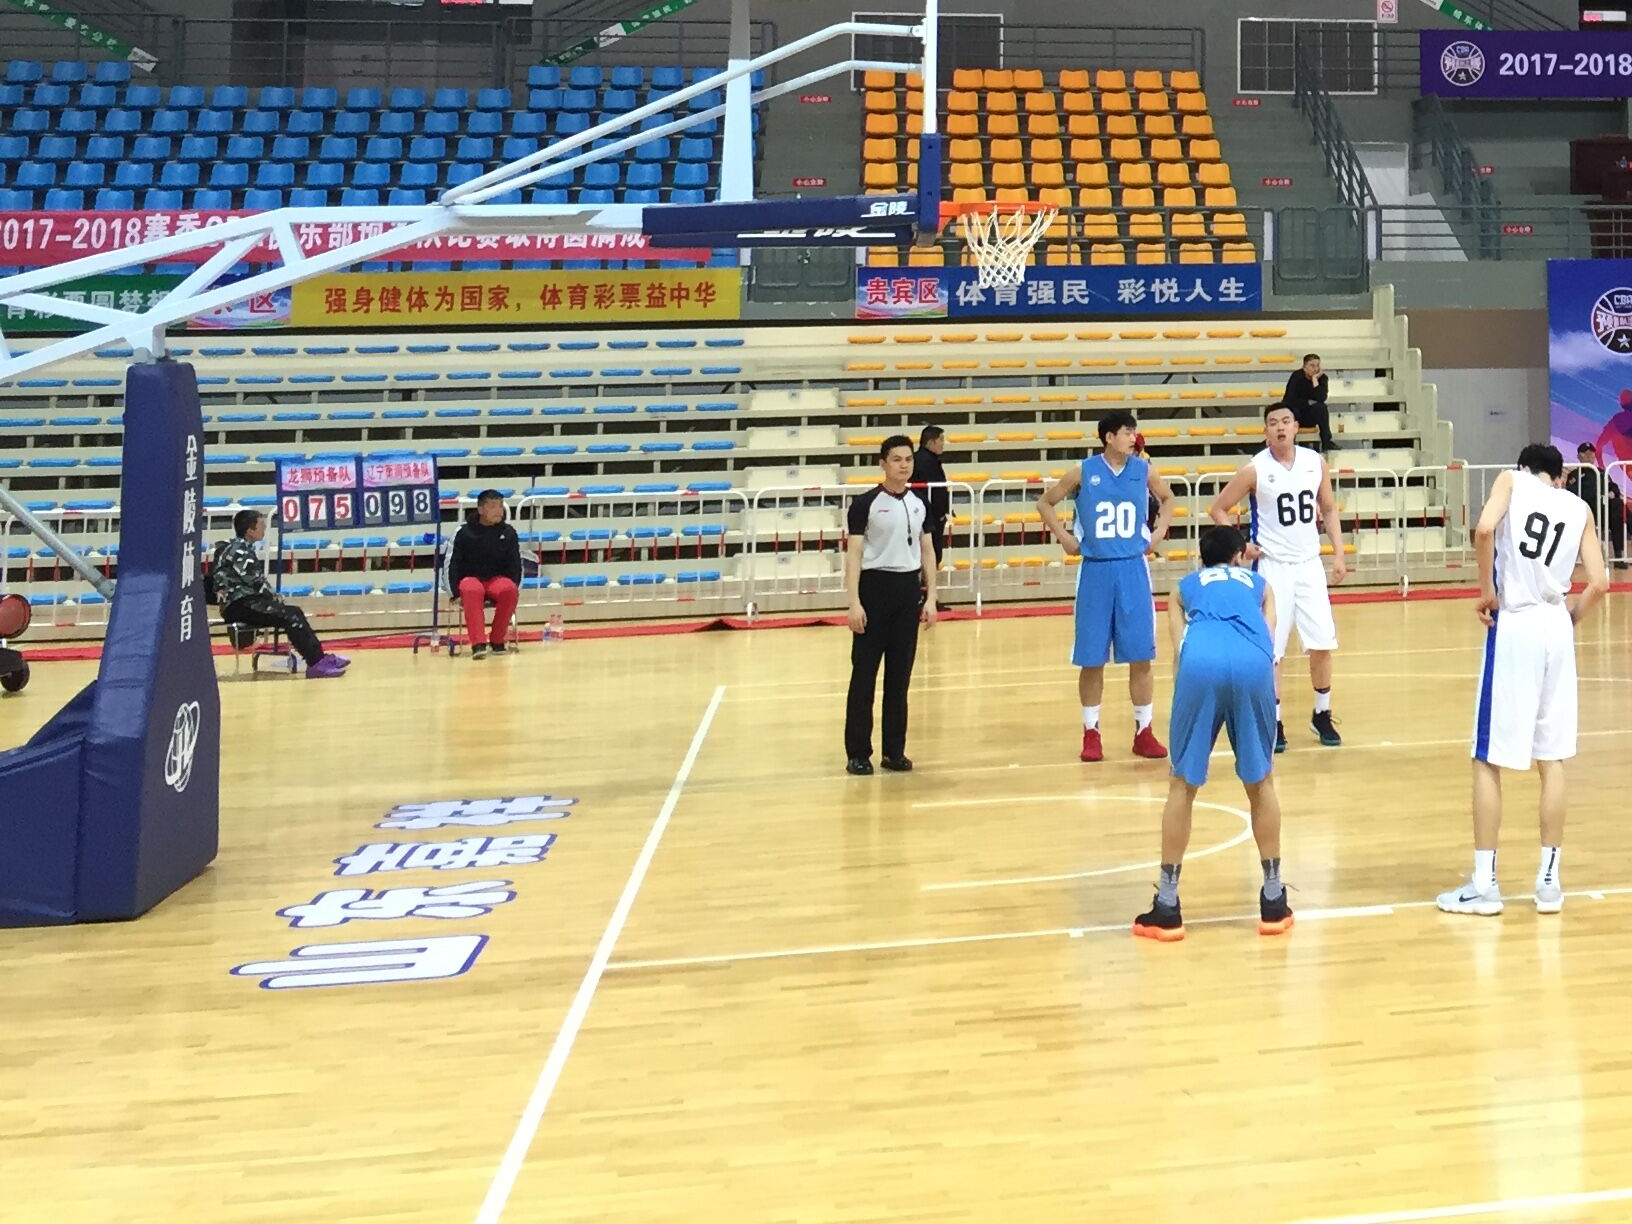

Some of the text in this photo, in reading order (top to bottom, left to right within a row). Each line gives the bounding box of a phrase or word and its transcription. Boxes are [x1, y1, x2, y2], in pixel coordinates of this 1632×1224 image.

[866, 276, 1247, 307] 贵宾区 体育强民 彩悦人生
[1095, 501, 1136, 538] 20
[1276, 489, 1315, 527] 66
[179, 435, 198, 642] 金陵体育
[1518, 511, 1566, 567] 91
